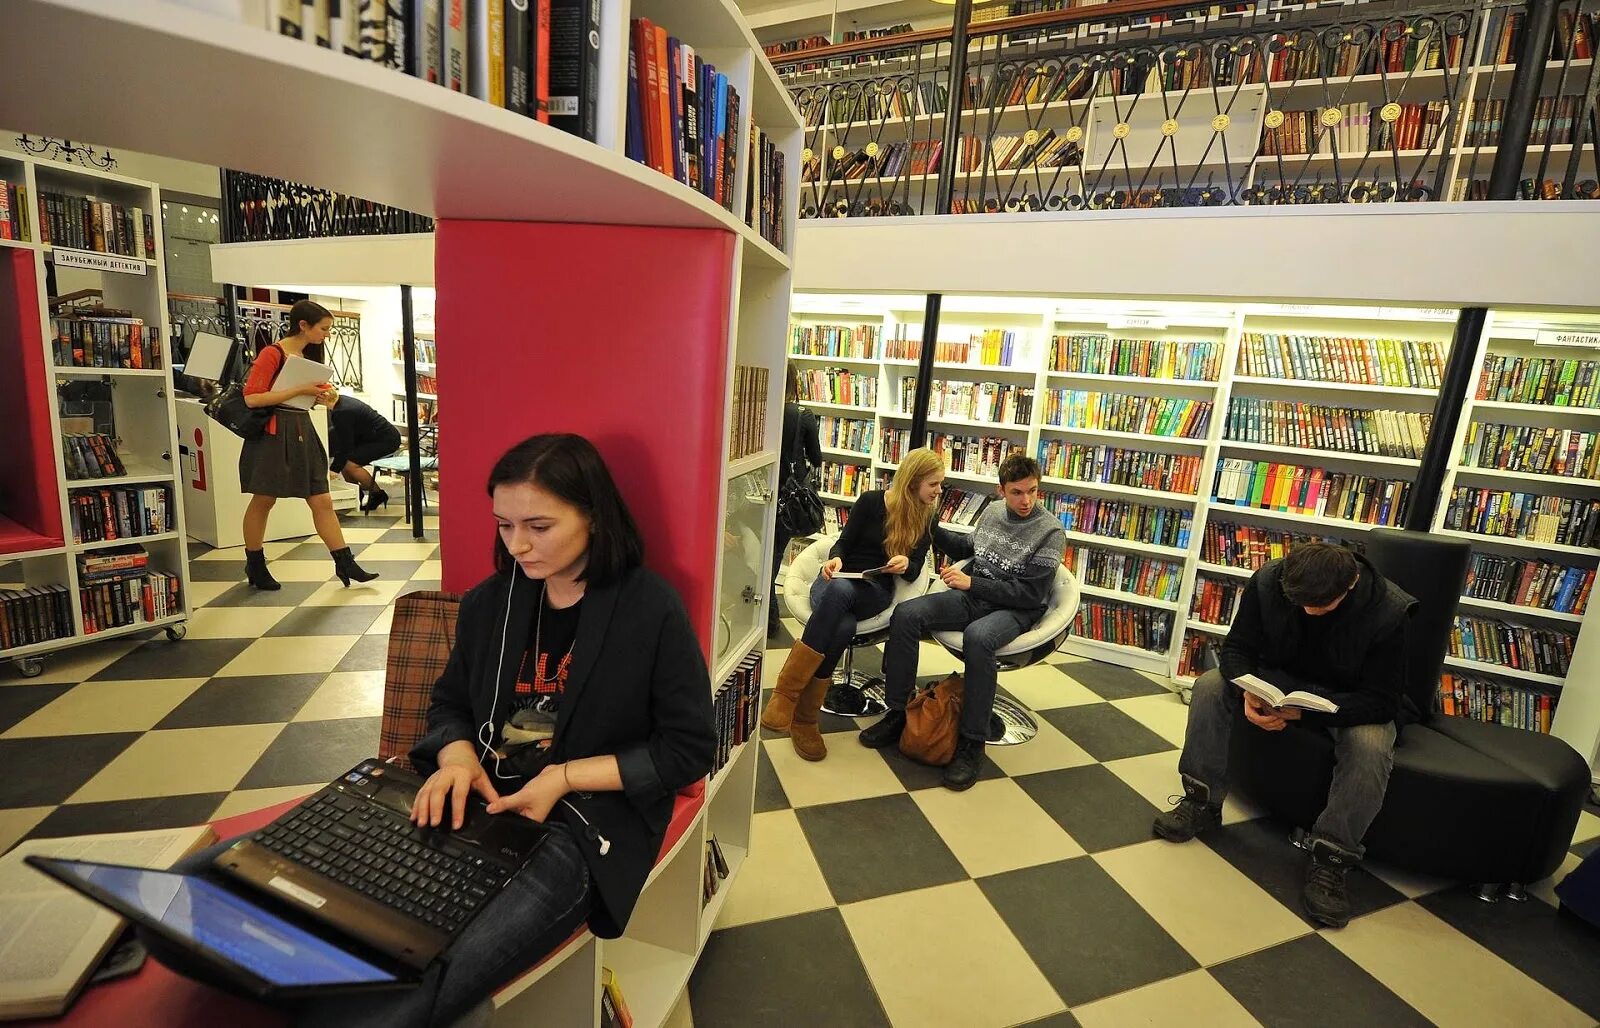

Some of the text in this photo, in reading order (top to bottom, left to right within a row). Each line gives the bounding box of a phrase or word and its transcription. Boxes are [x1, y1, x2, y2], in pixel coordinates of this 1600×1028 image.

[61, 254, 141, 271] ЗАРУБЕЖНЫЙ ДЕТЕКТИВ
[1556, 335, 1600, 345] ФАНТАСТИК
